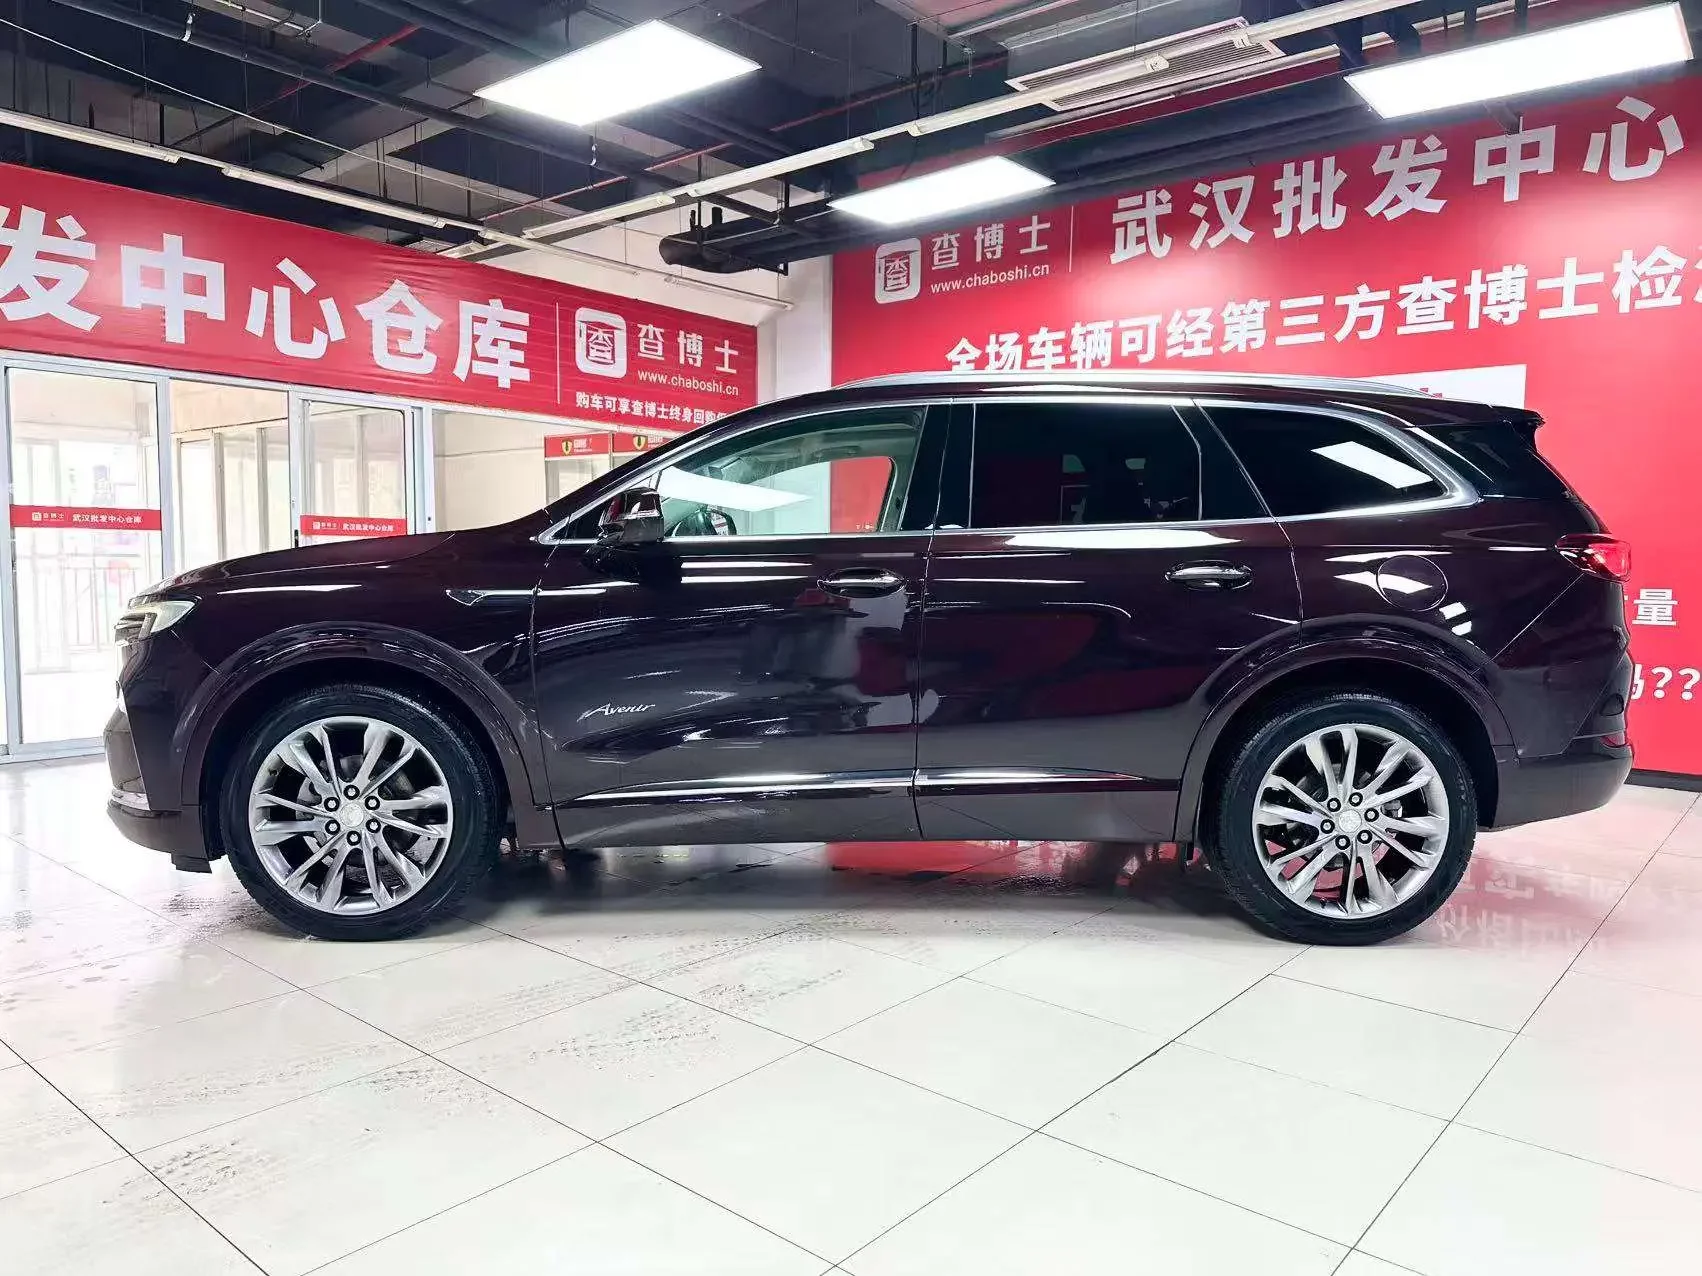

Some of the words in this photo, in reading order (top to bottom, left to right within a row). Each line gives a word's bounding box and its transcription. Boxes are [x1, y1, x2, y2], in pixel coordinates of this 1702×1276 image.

[1110, 96, 1685, 265] 武汉批发中心
[931, 215, 1051, 271] 查博士
[0, 205, 531, 389] 发中心仓库
[930, 263, 1050, 294] www.chaboshi.cn
[637, 324, 739, 374] 查博士
[638, 370, 739, 396] www.chaboshi.cn
[1624, 588, 1679, 626] 量
[577, 703, 656, 722] Avenir
